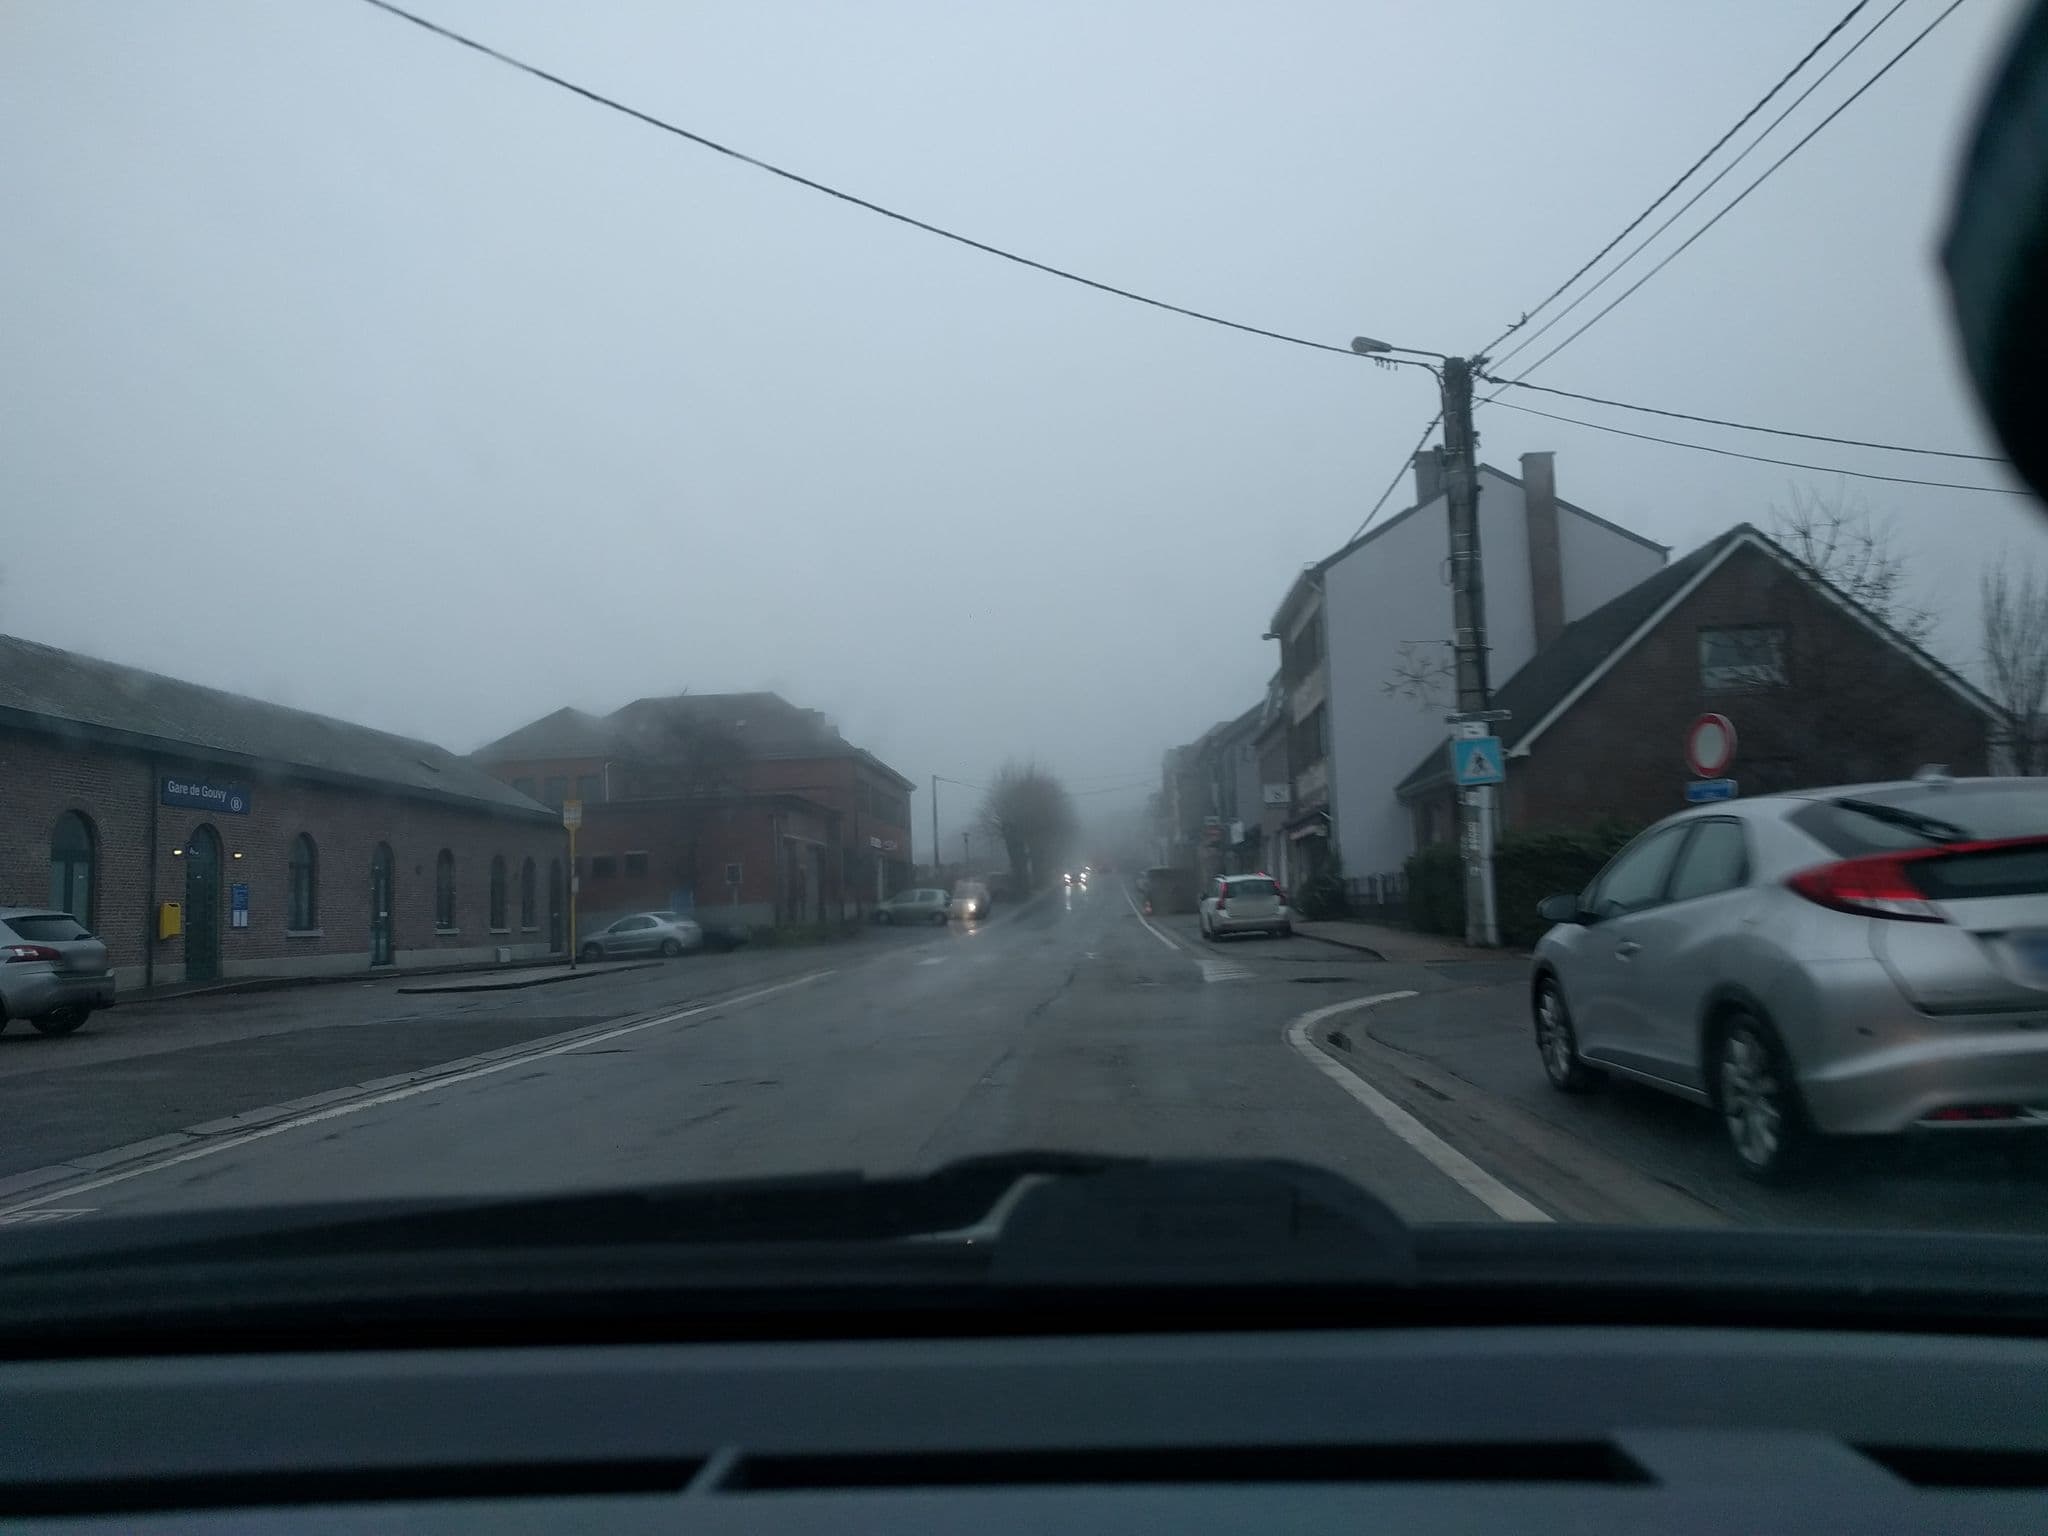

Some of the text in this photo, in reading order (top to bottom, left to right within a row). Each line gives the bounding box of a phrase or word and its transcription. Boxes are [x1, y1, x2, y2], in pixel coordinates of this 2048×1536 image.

[168, 780, 227, 803] Gare de Gouvy
